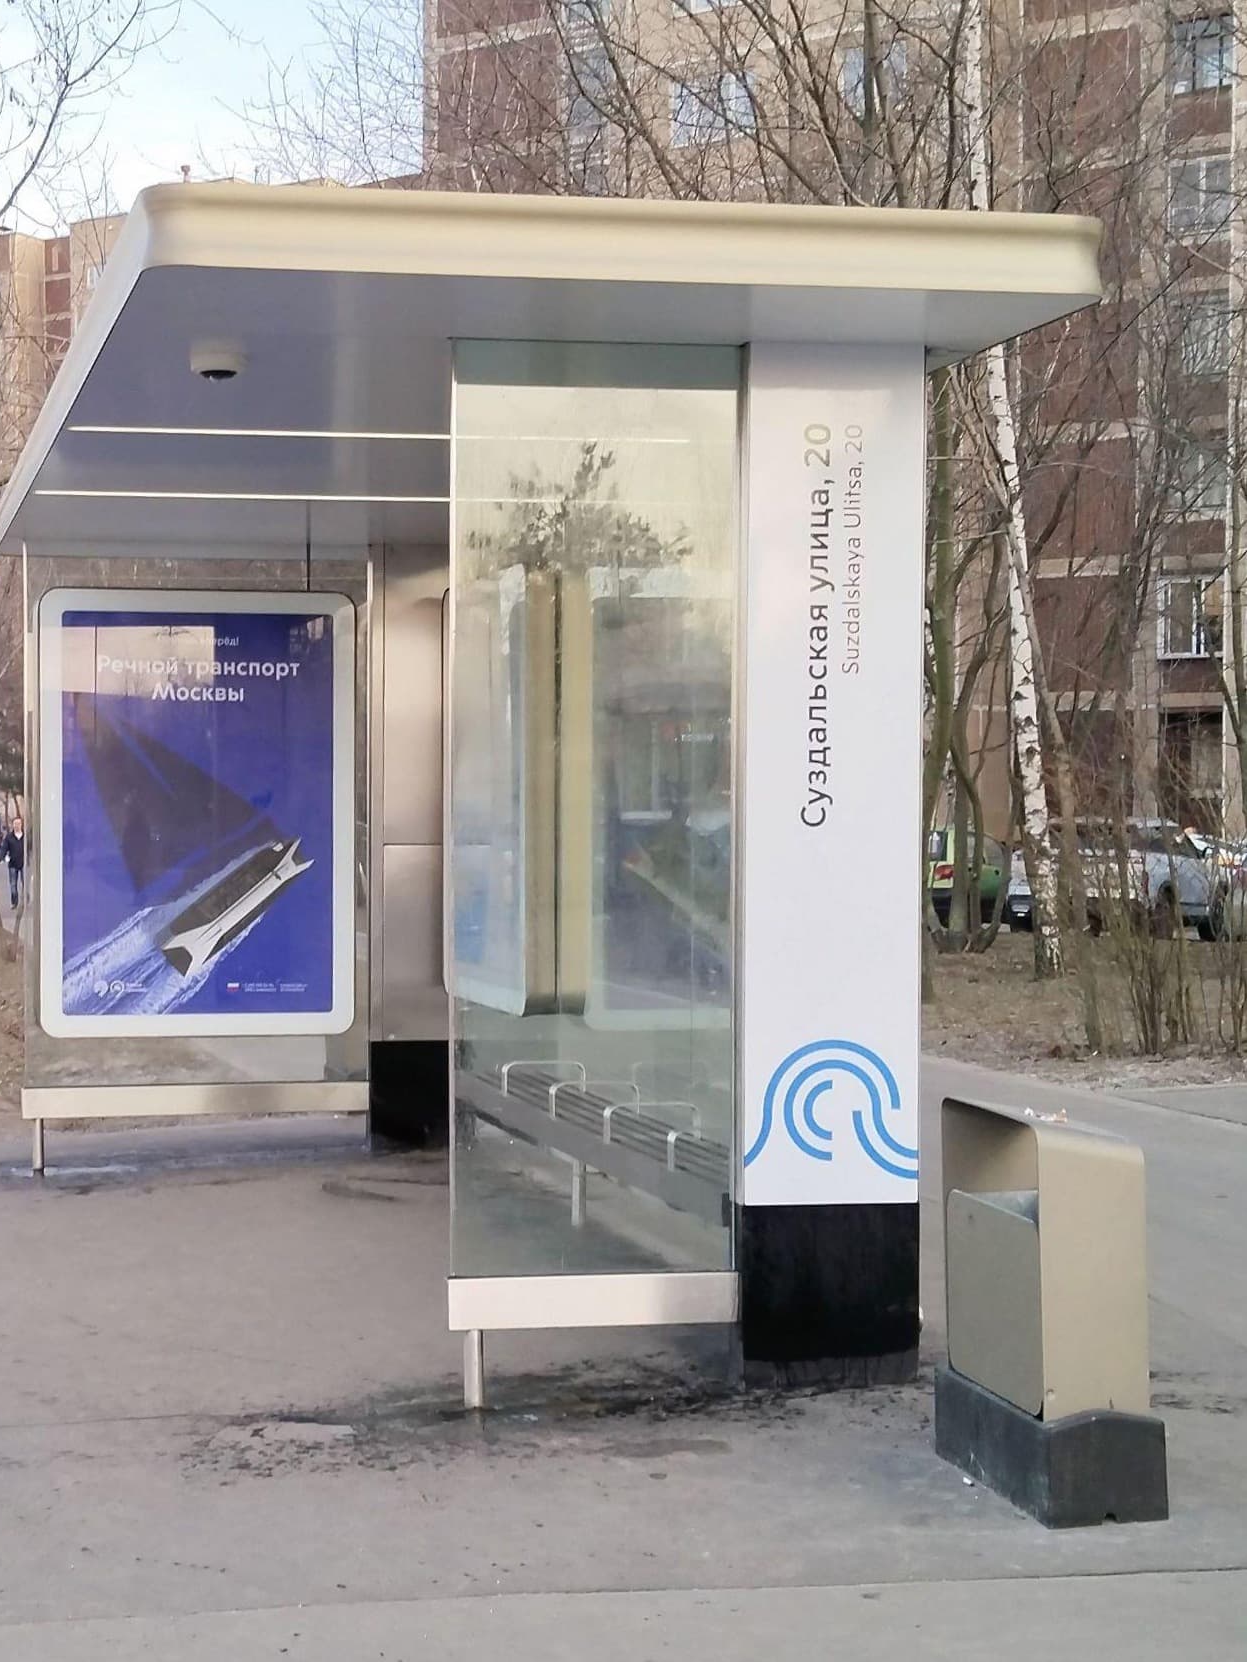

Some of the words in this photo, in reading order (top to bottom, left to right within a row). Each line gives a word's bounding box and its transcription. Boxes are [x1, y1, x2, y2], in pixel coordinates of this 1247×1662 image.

[804, 423, 831, 467] 20
[845, 424, 862, 451] 20
[843, 461, 865, 528] Ulitsa,
[810, 479, 835, 592] улица,
[841, 537, 865, 674] Suzdalskaya
[97, 655, 178, 676] Речной
[186, 660, 301, 681] транспорт
[151, 682, 245, 703] Москвы
[800, 604, 832, 827] Суздальская
